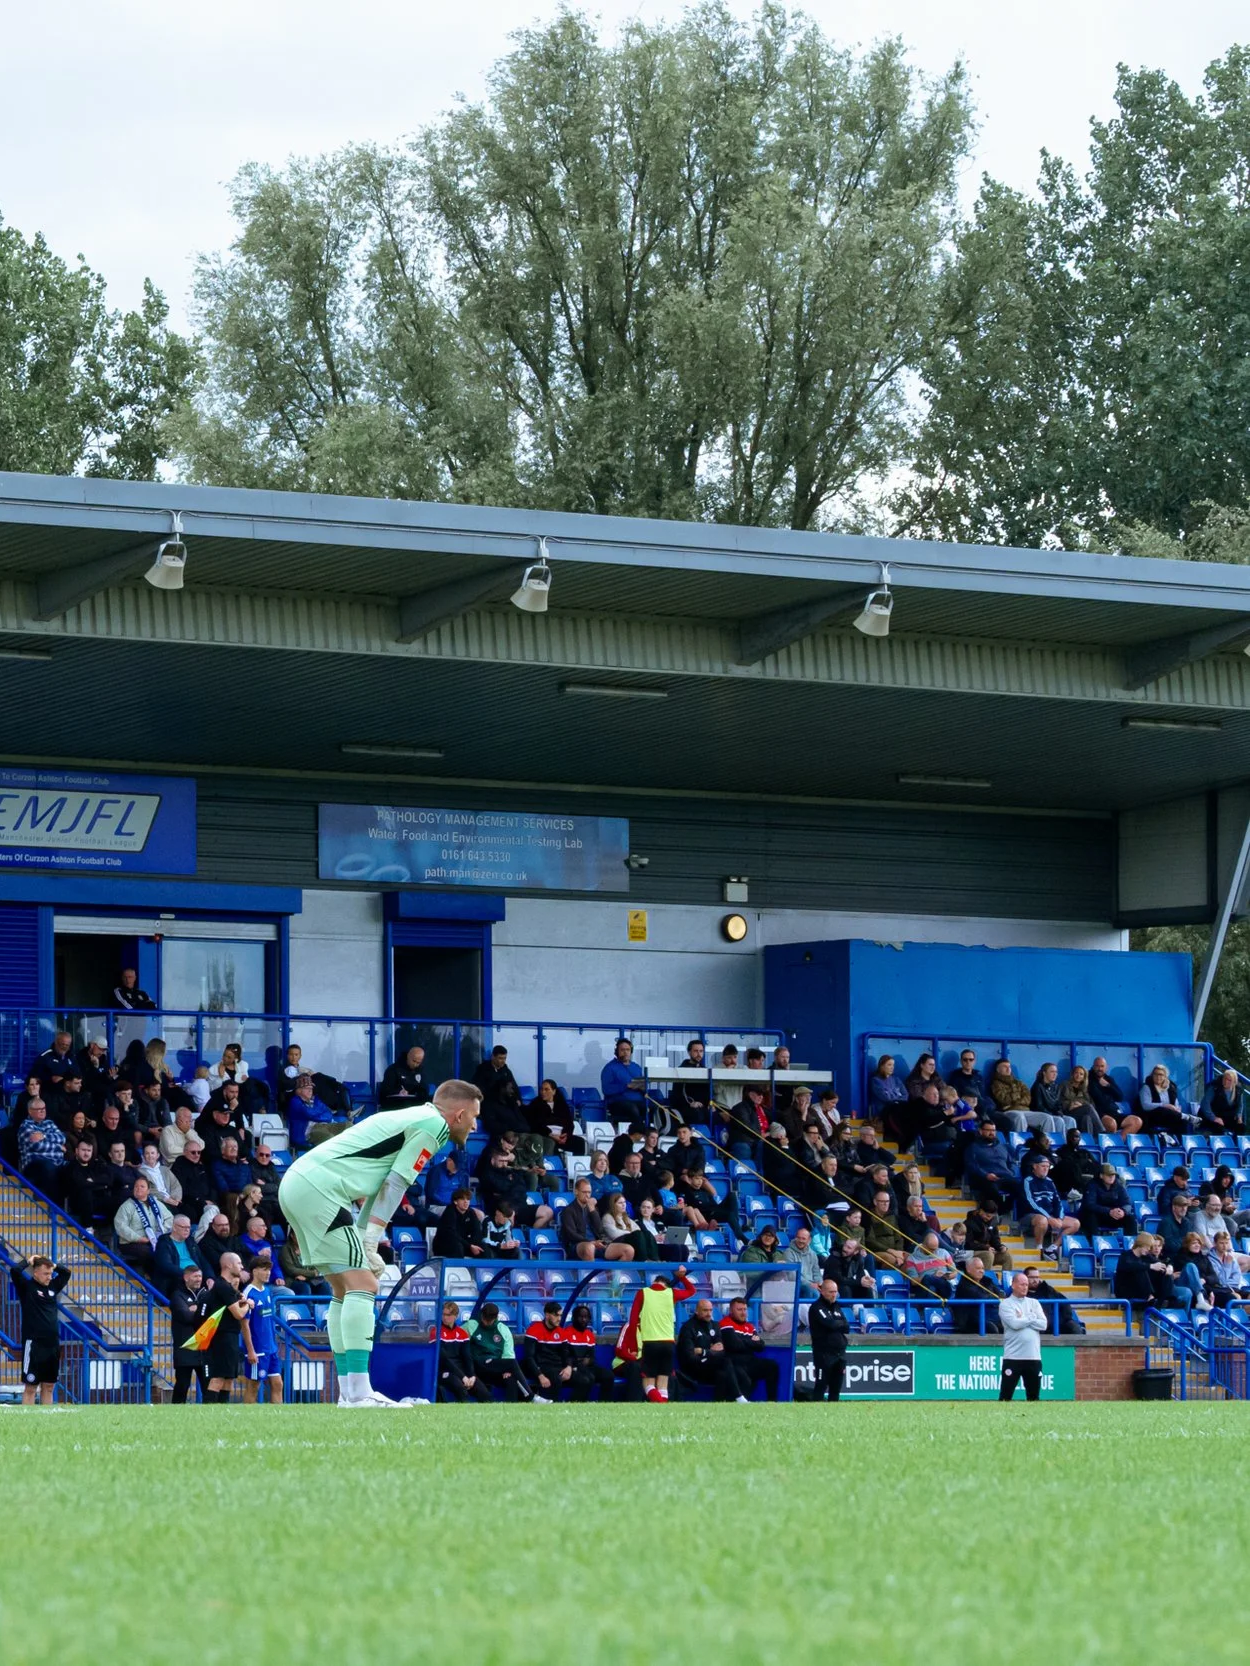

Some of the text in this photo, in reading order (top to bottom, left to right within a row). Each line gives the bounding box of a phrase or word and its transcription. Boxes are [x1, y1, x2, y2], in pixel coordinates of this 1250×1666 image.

[12, 773, 36, 782] Curzon
[37, 774, 63, 783] Ashton
[64, 776, 92, 785] Football
[93, 777, 109, 786] Club
[377, 810, 575, 831] PATHOLOGY MANAGEMENT SERVICES
[402, 830, 428, 841] Food
[431, 832, 449, 842] and
[452, 832, 524, 846] Environmental
[527, 835, 562, 850] Testing
[564, 837, 584, 849] Lab
[14, 853, 23, 861] Of
[24, 854, 50, 863] Curzon
[50, 855, 76, 864] Ashton
[77, 856, 105, 865] Football
[105, 858, 122, 866] Club
[441, 848, 511, 862] 0161 643 5330
[412, 1285, 437, 1295] AWAY
[969, 1355, 996, 1371] HERE
[935, 1374, 955, 1390] THE
